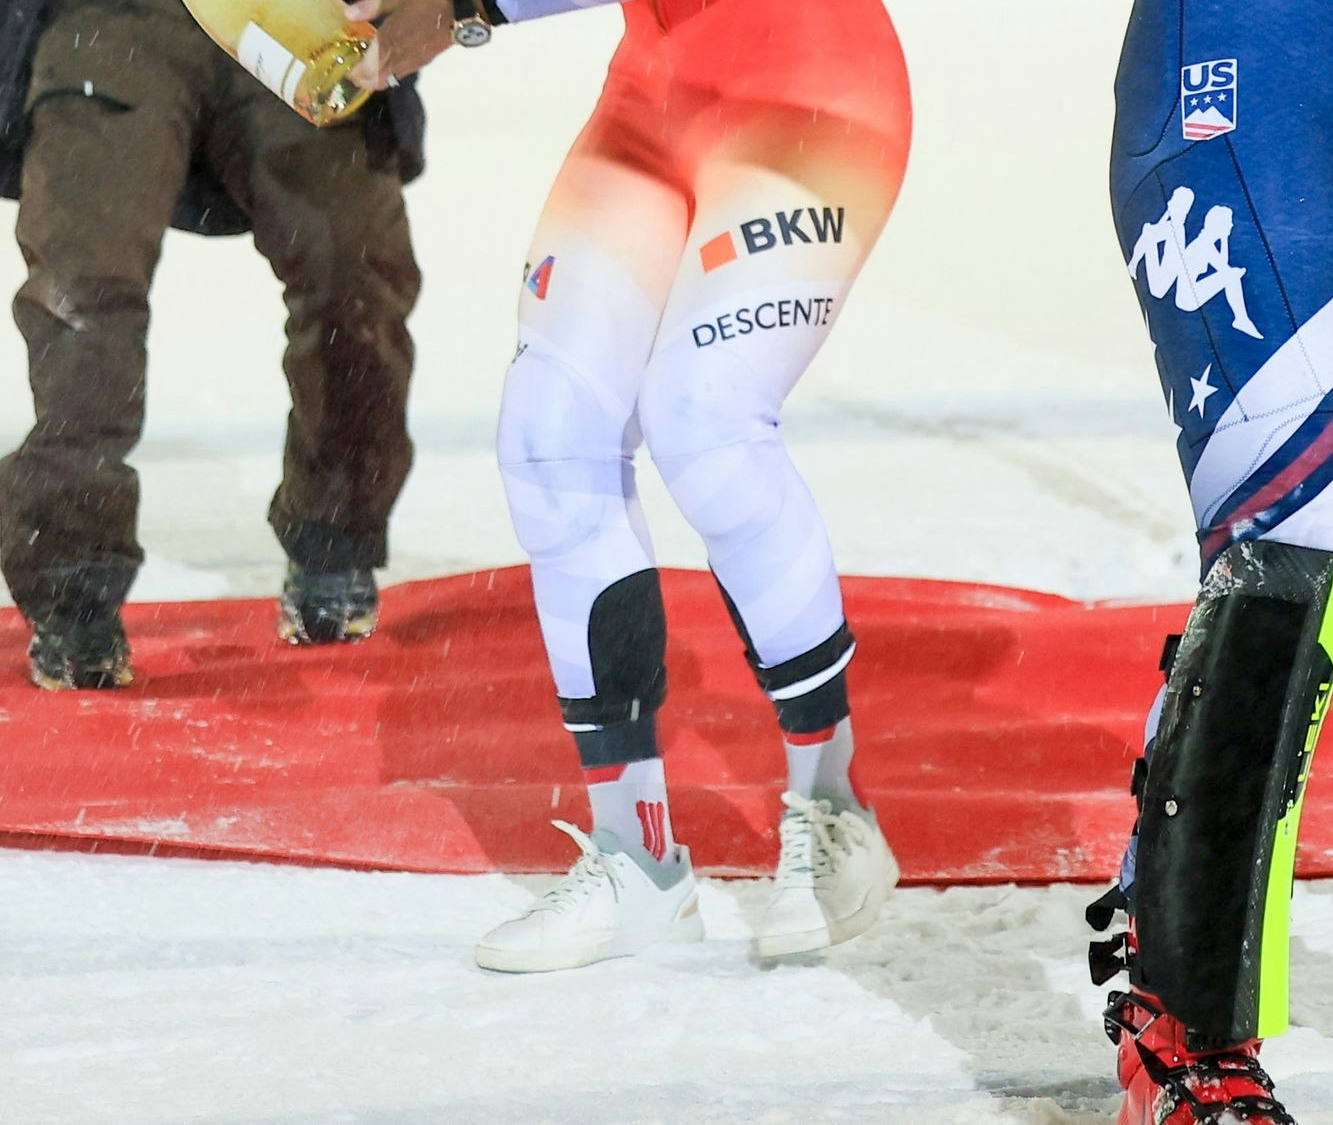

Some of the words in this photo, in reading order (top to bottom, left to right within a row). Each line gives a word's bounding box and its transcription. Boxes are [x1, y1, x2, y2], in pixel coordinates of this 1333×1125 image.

[1182, 62, 1235, 90] US
[741, 208, 845, 255] BKW
[692, 297, 834, 348] DESCENTE
